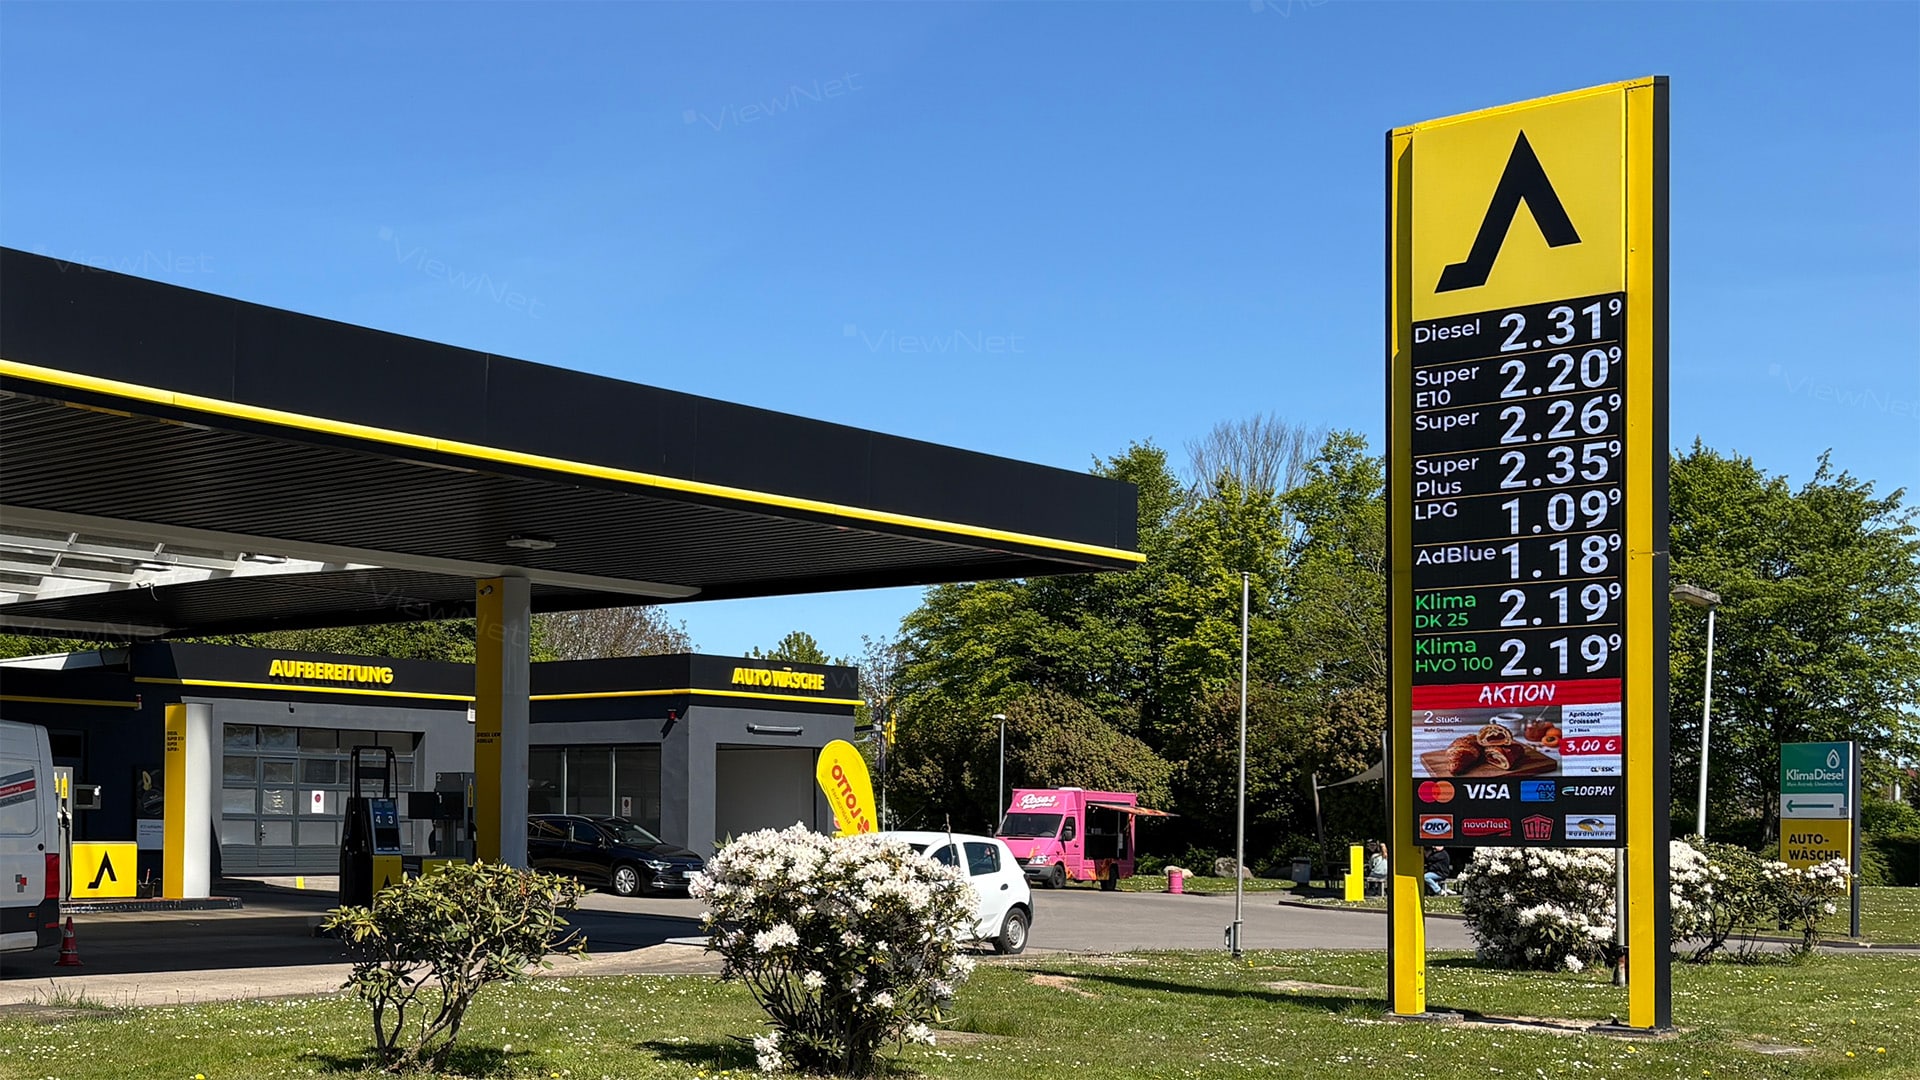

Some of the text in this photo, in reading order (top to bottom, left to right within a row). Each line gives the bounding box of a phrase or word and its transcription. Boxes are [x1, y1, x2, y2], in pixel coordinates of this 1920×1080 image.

[1414, 319, 1481, 344] Diesel
[1415, 366, 1480, 387] Super
[1416, 389, 1451, 408] E10
[1415, 411, 1480, 432] Super
[1415, 457, 1480, 477] Super
[1416, 480, 1462, 497] Plus
[1415, 502, 1458, 520] LPG
[1415, 545, 1497, 565] AdBlue
[1415, 593, 1477, 611] Klima
[1415, 612, 1469, 628] DK 25
[1415, 638, 1477, 656] Klima
[269, 659, 394, 684] AUFBEREITUNG
[1415, 656, 1493, 672] HVO 100
[1478, 684, 1556, 705] AKTION
[1424, 711, 1434, 724] 2
[1566, 739, 1616, 753] 3,00 €
[1786, 768, 1844, 780] KlimaDiesel
[1462, 784, 1511, 799] VISA
[1574, 786, 1616, 796] LOGPAY
[1425, 822, 1449, 830] DKV
[1788, 834, 1829, 845] AUTO-
